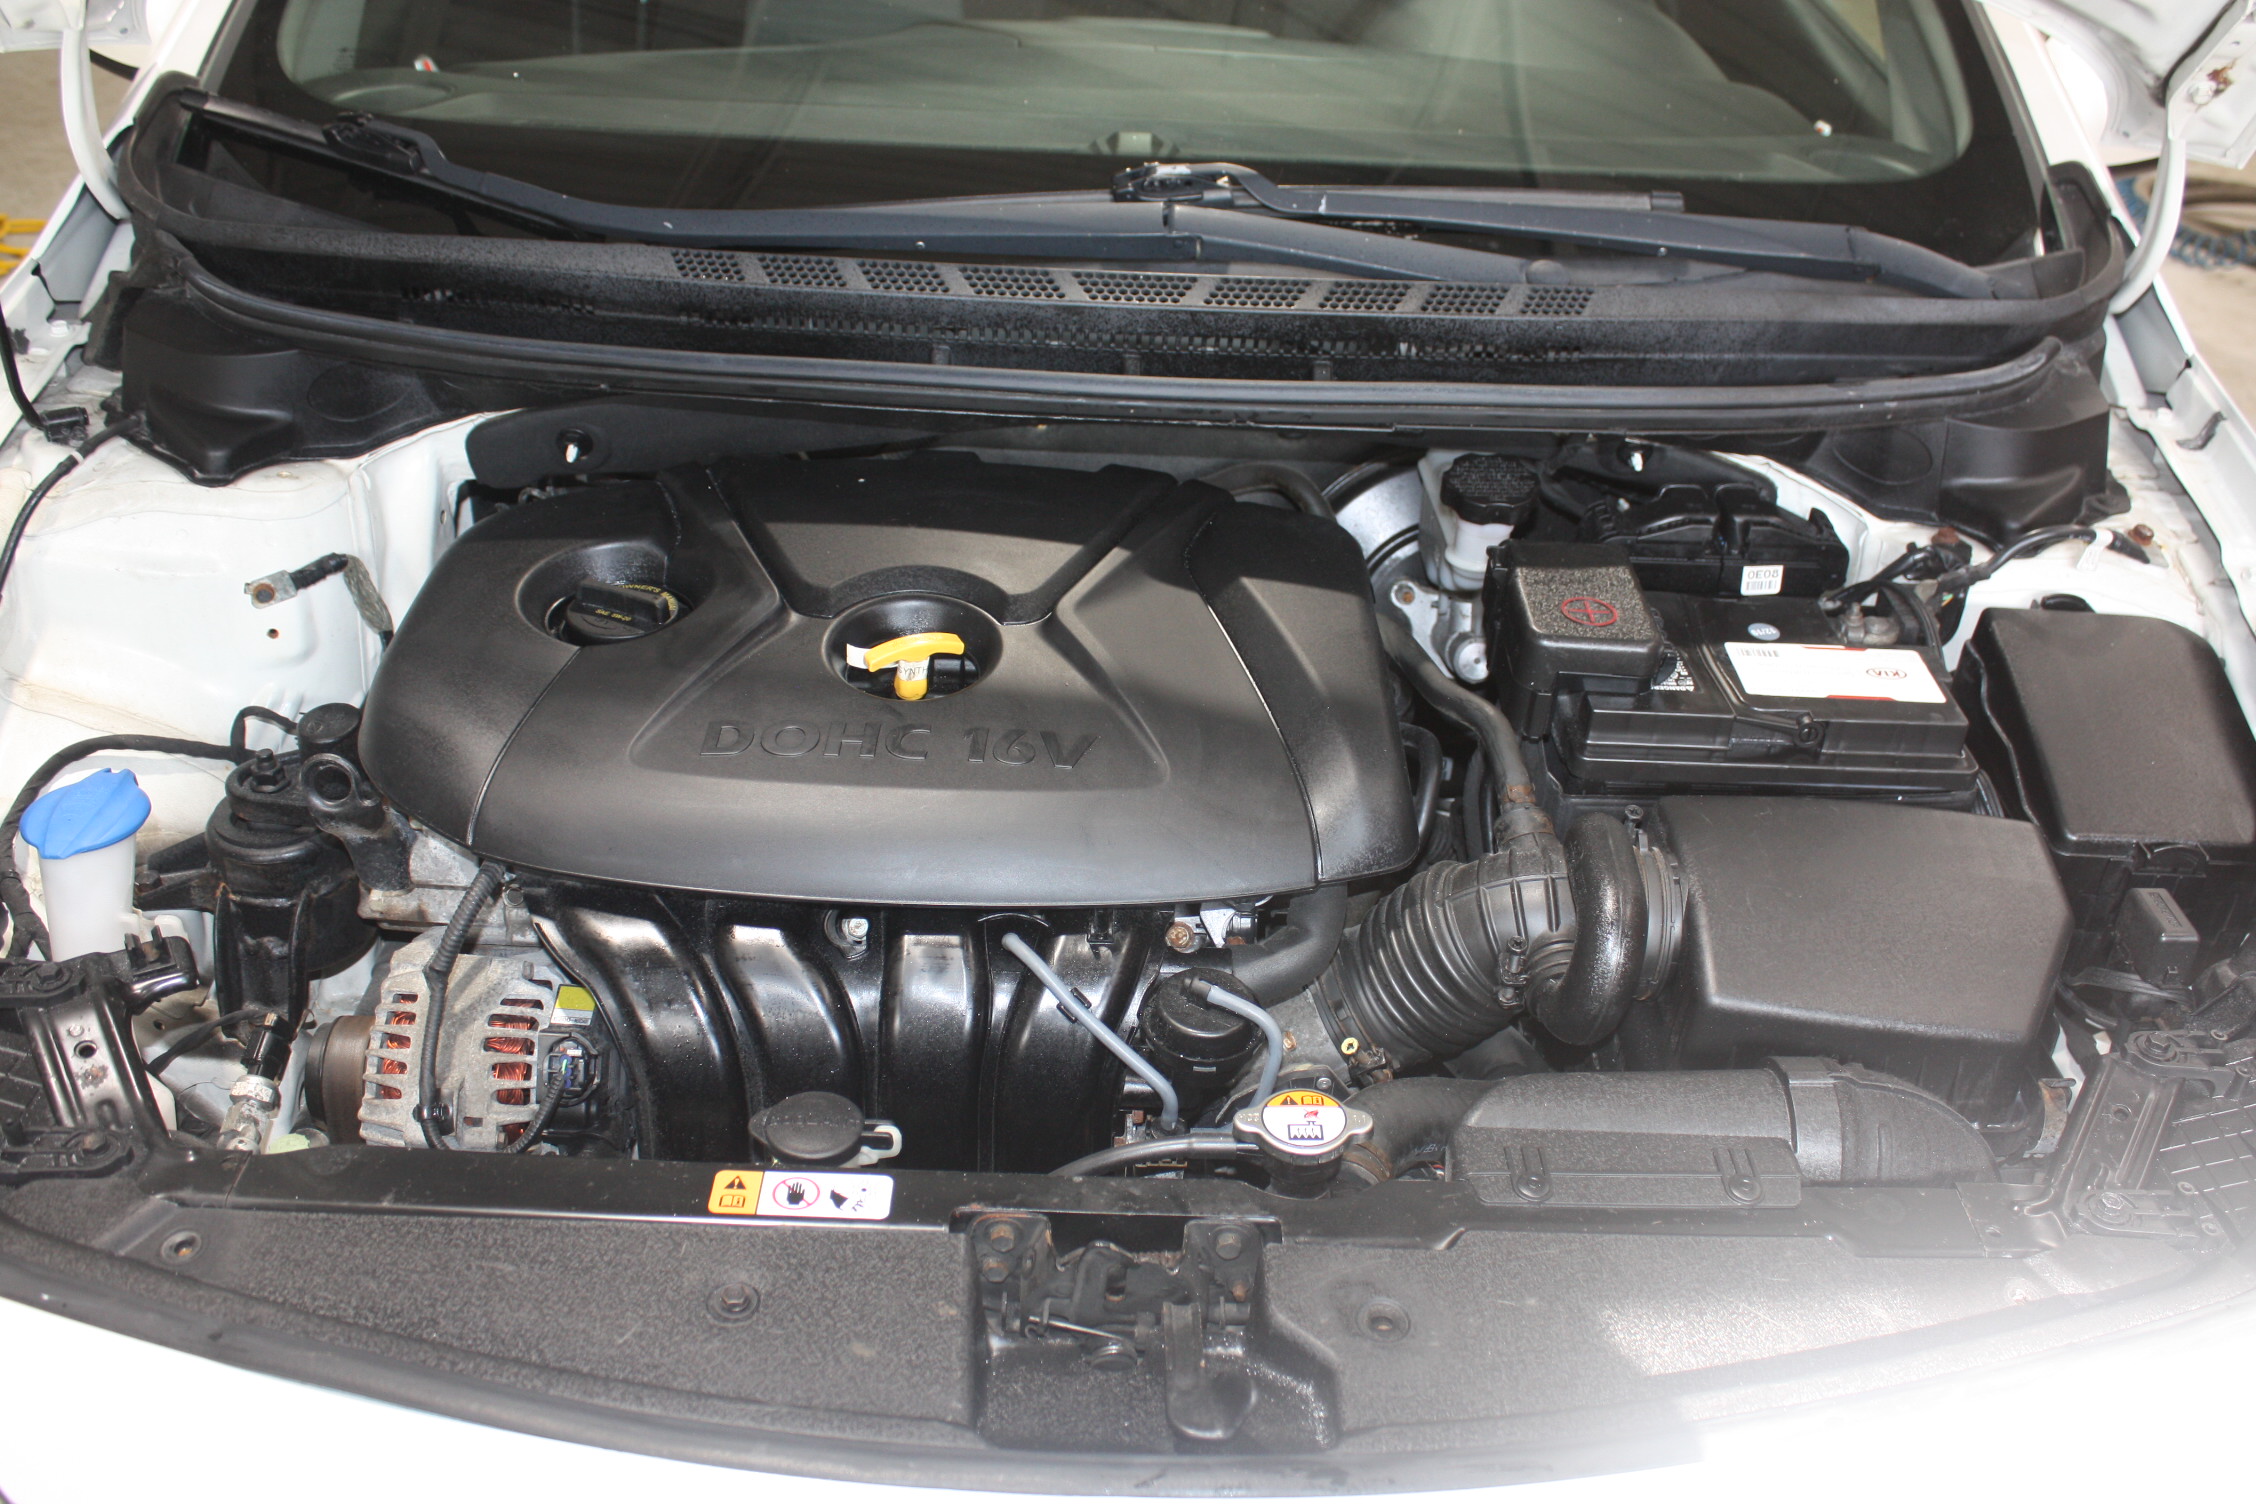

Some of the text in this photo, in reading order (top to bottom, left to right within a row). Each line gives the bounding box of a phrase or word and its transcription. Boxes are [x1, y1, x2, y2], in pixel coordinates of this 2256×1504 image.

[621, 583, 661, 593] WNER'S
[1872, 668, 1901, 678] KIA
[700, 719, 1098, 769] DOHC 16V
